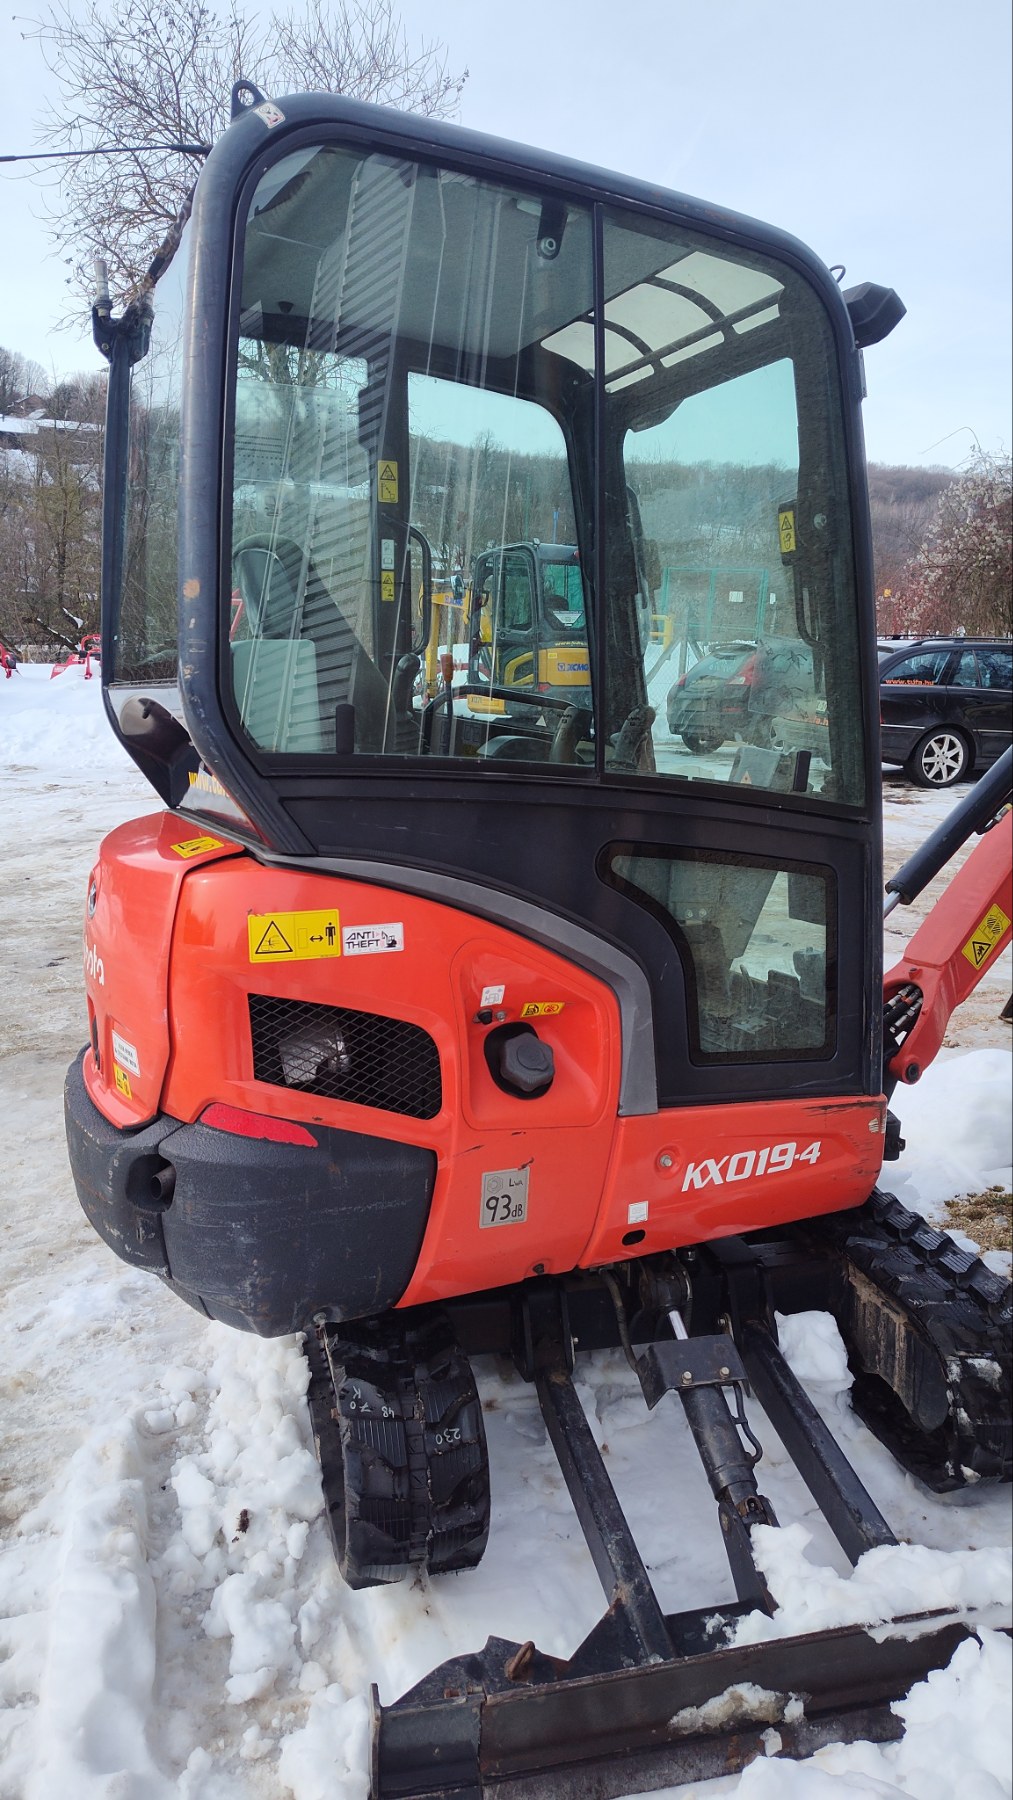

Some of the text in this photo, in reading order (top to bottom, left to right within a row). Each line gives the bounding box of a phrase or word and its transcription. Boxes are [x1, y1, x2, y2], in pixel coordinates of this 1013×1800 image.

[346, 931, 375, 940] ANTI
[345, 939, 381, 949] THEFT
[681, 1141, 821, 1192] KX019-4
